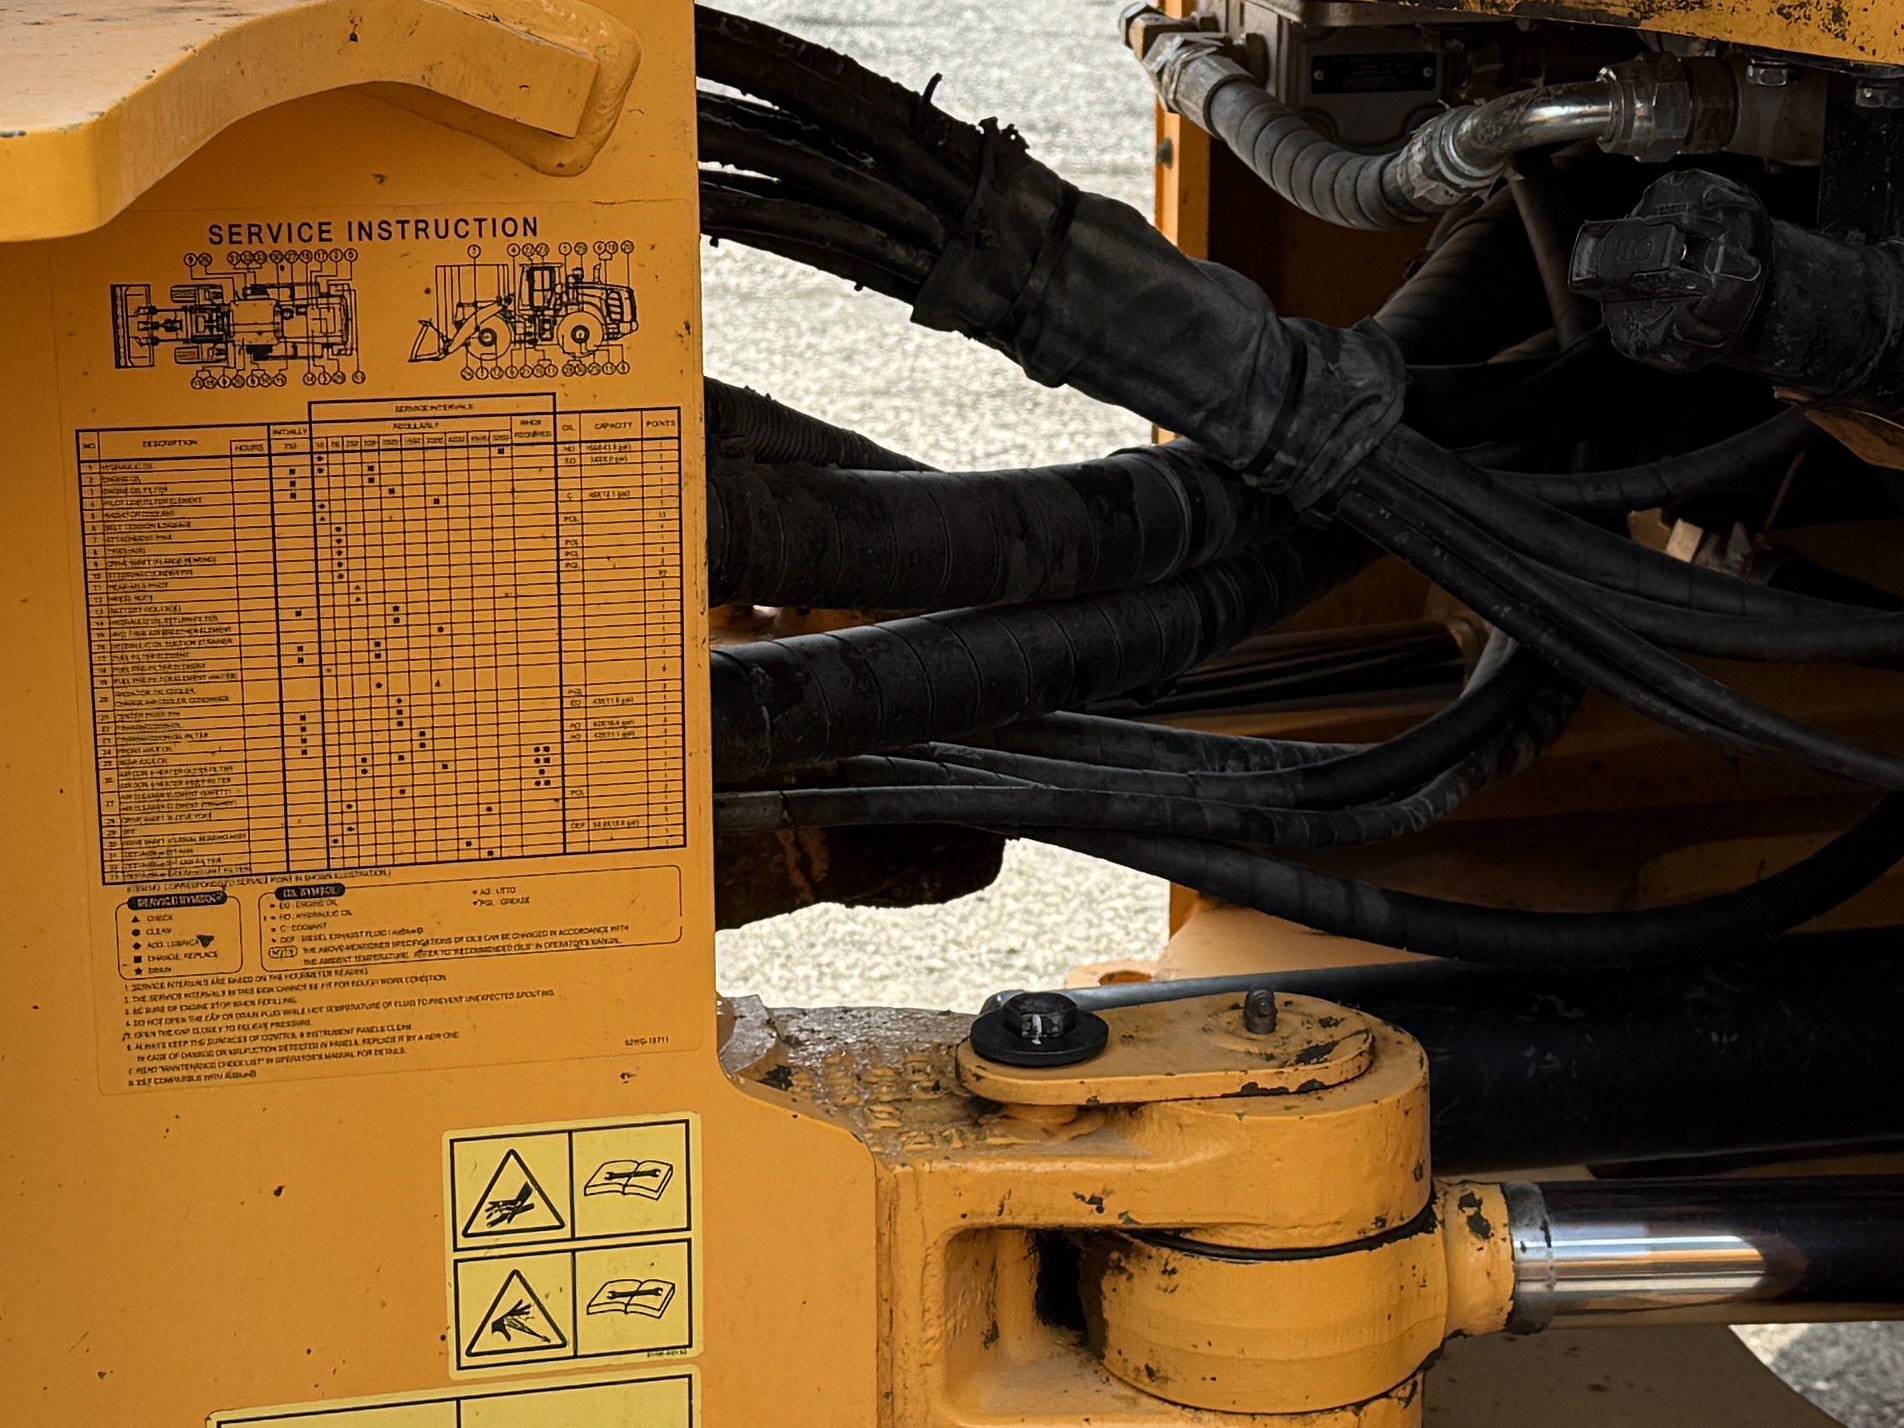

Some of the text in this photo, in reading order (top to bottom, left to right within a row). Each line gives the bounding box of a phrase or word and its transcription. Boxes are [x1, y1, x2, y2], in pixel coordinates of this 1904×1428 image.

[209, 217, 541, 245] SERVICE INSTRUCTION
[595, 422, 633, 430] CAPACITY
[646, 419, 675, 428] POINTS
